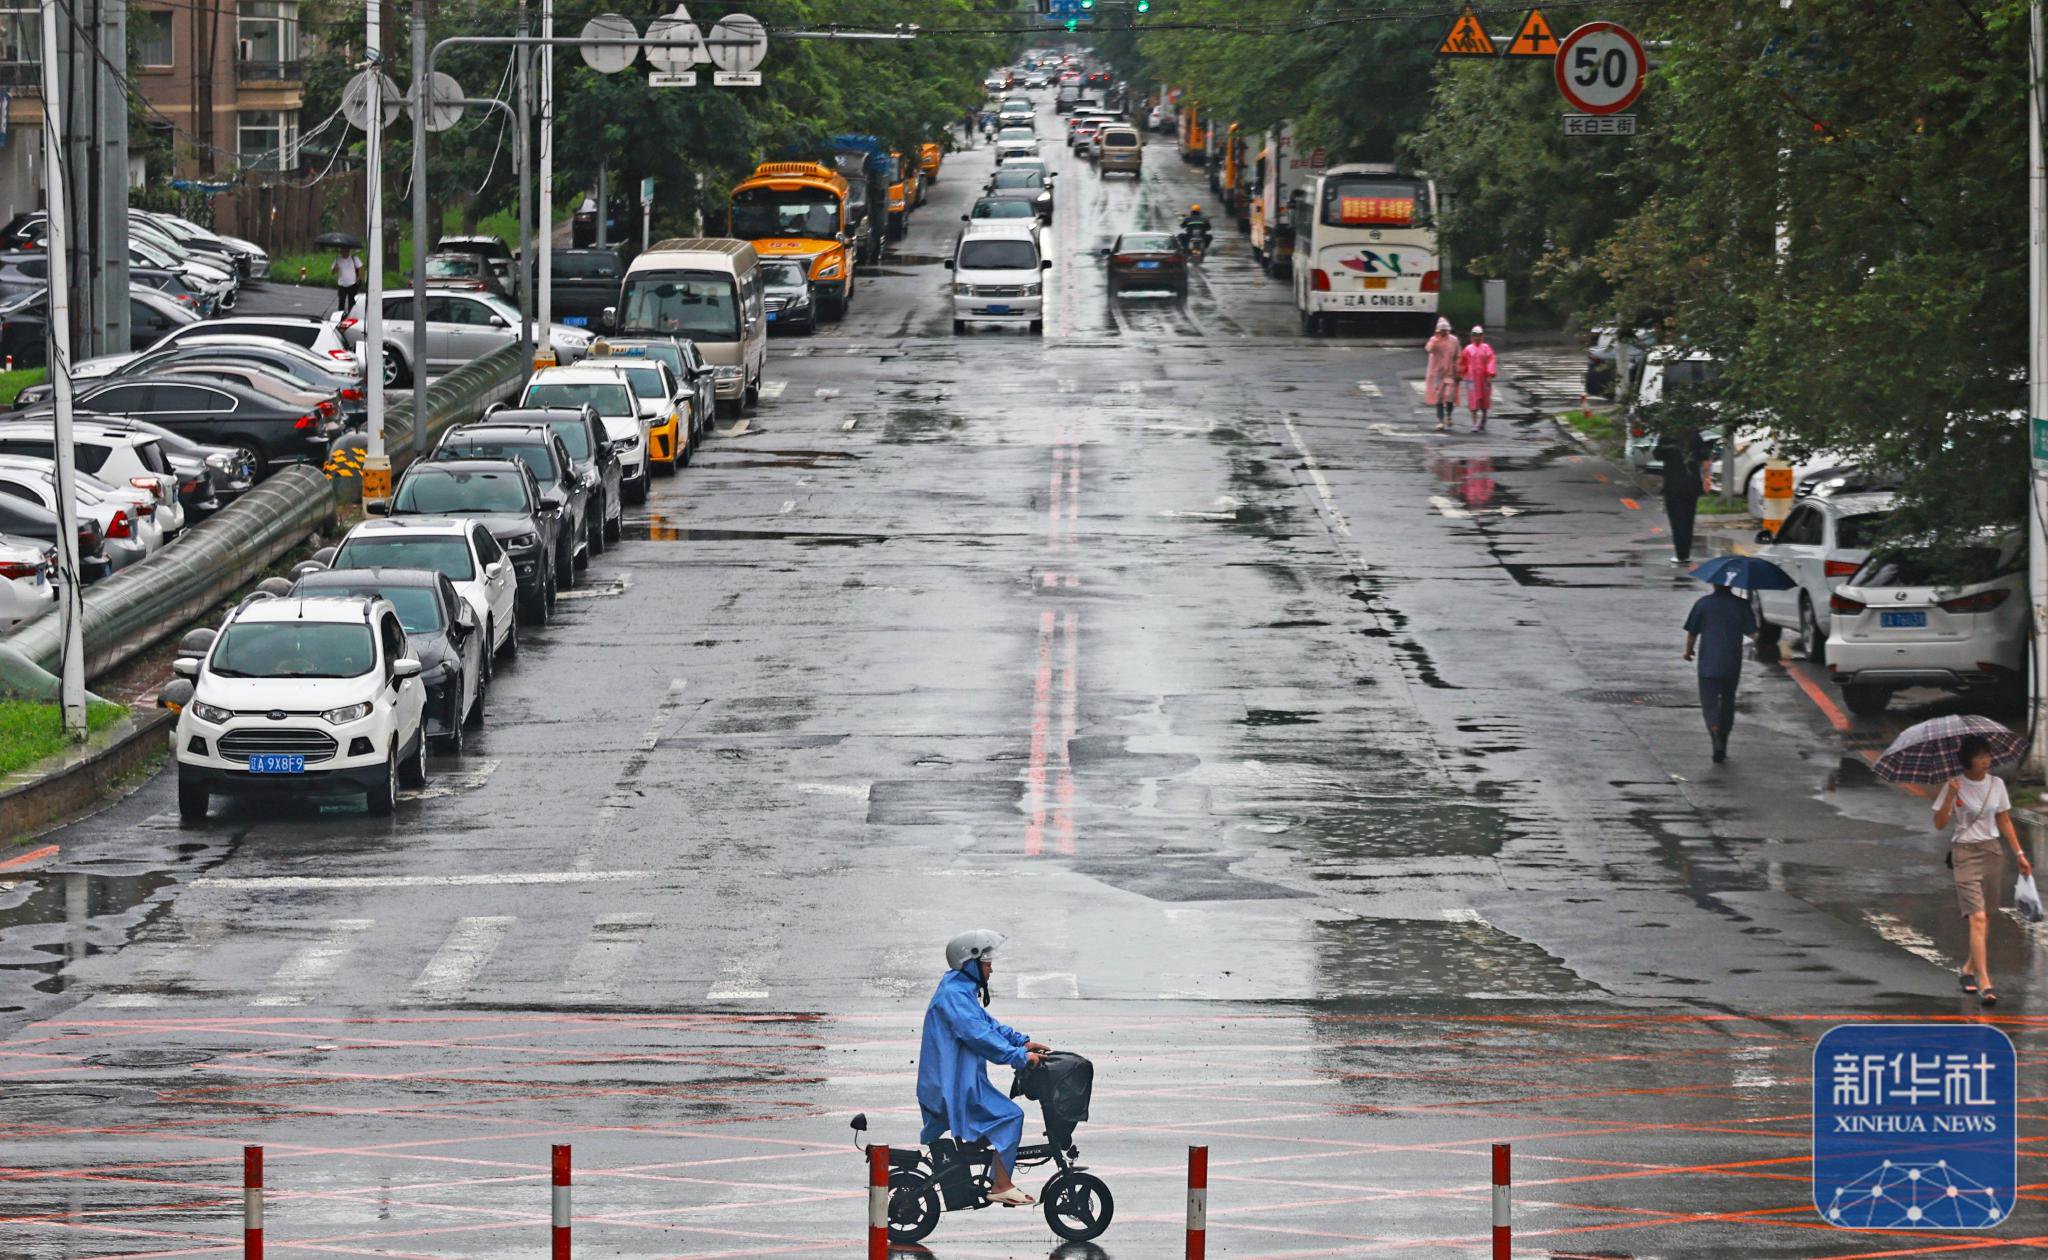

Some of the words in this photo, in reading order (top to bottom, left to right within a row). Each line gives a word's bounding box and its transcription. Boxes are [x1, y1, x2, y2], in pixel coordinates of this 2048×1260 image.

[1574, 47, 1627, 88] 50
[1568, 119, 1632, 133] 长白三街
